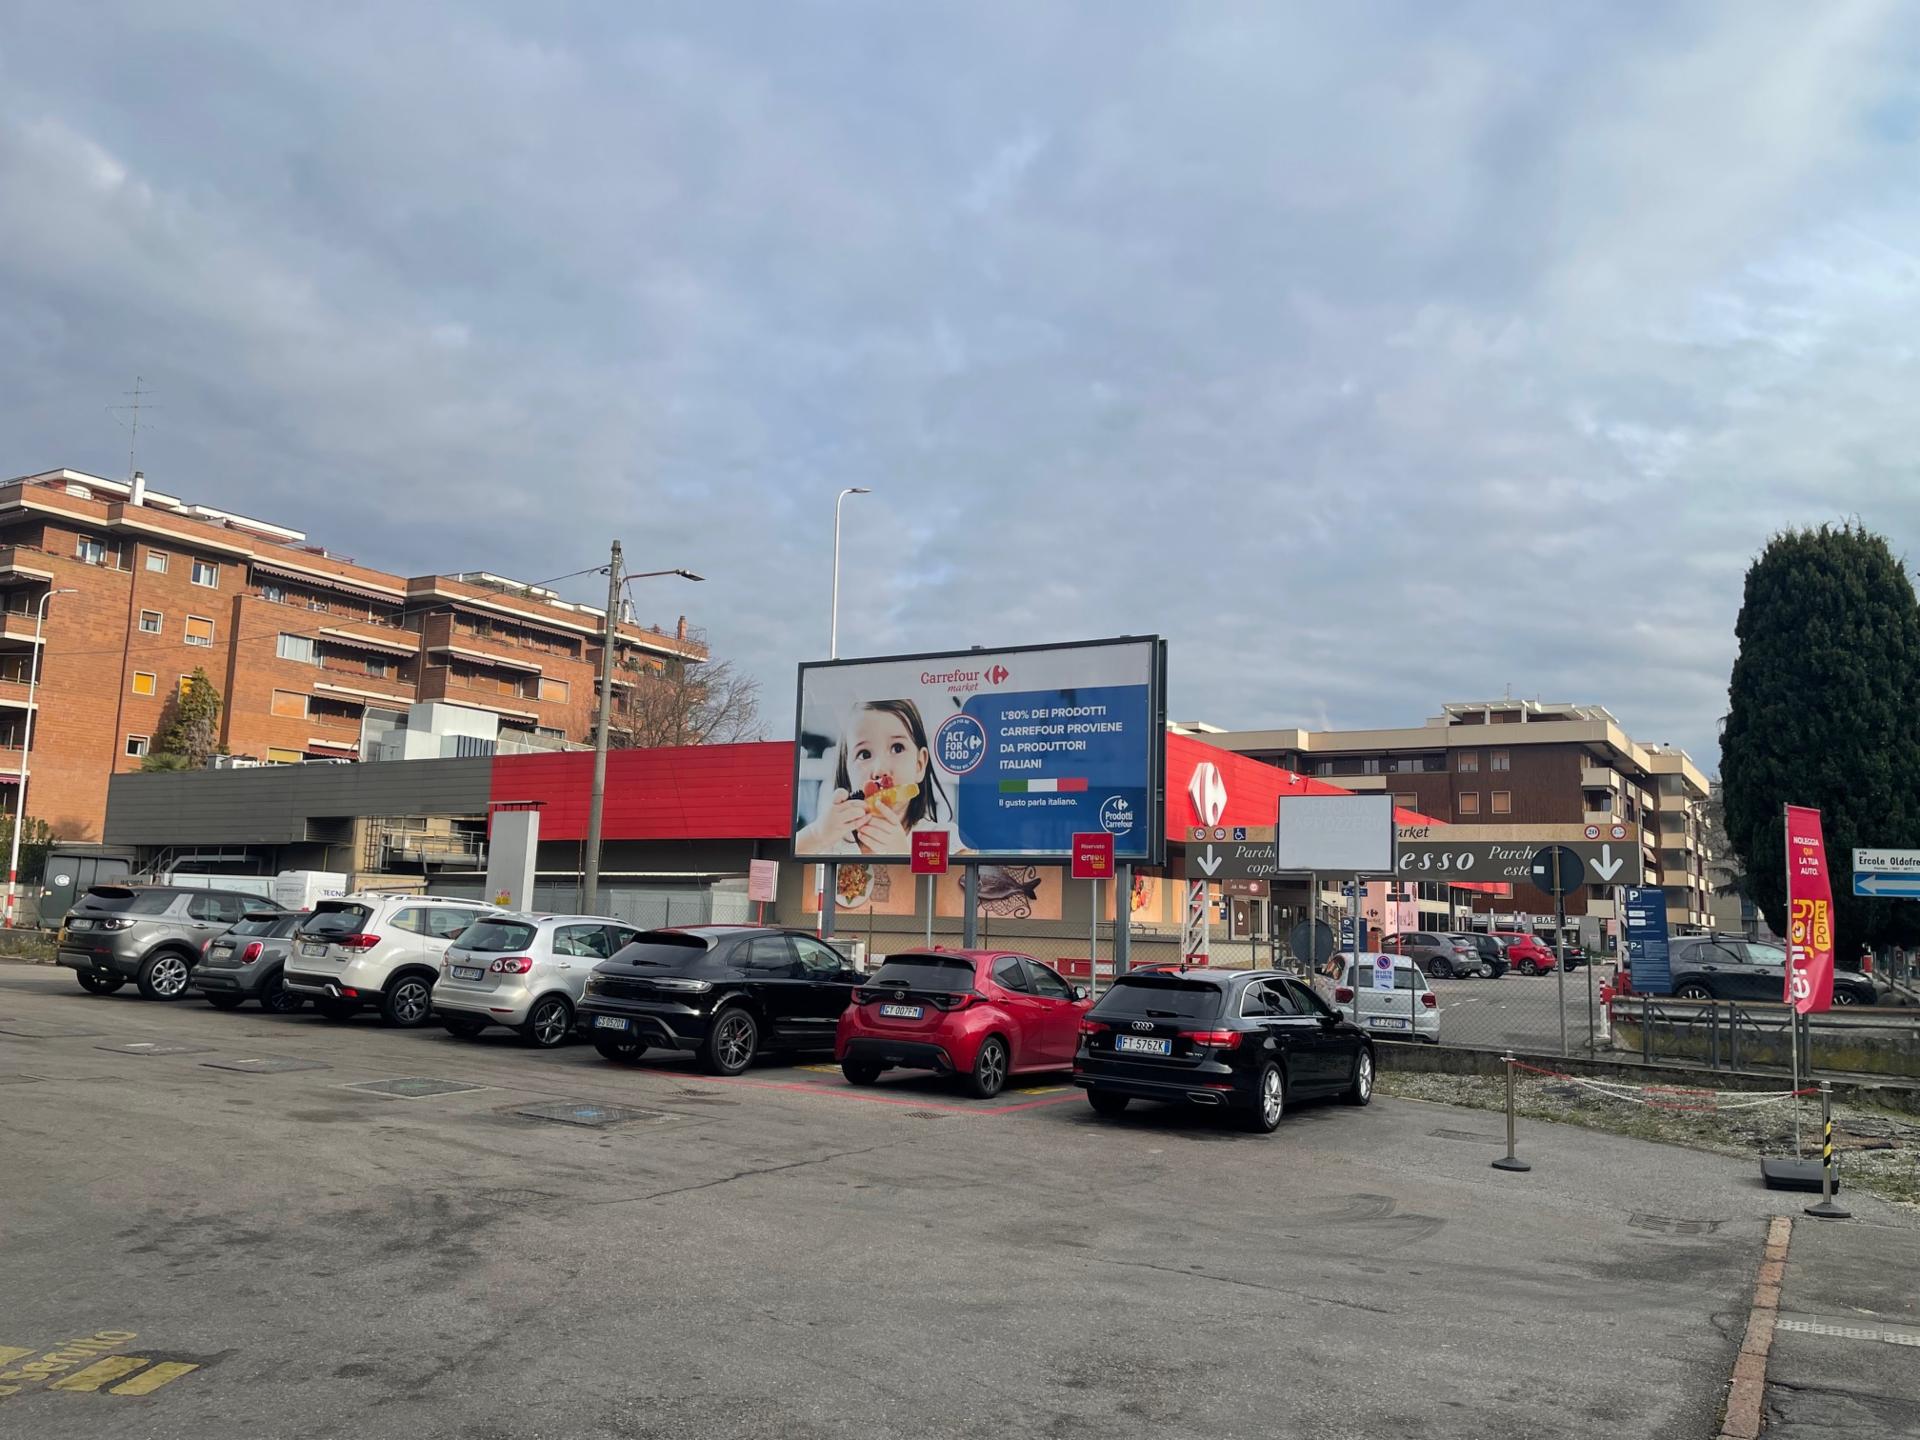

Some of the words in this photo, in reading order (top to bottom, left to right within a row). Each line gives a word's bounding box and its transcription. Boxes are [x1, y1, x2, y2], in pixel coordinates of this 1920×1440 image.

[920, 669, 979, 685] Carrefour
[947, 682, 978, 692] market
[1001, 709, 1029, 720] L'80%
[1031, 708, 1049, 719] DEI
[1051, 706, 1106, 718] PRODOTTI
[1000, 724, 1064, 736] CARREFOUR
[1067, 722, 1123, 733] PROVIENE
[945, 730, 964, 742] ACT
[945, 741, 963, 751] FOR
[1000, 743, 1015, 753] DA
[1017, 740, 1087, 752] PRODUTTORI
[945, 750, 969, 760] FOOD
[999, 759, 1042, 770] ITALIANI
[1005, 799, 1026, 808] gusto
[1027, 798, 1046, 807] parla
[1048, 797, 1078, 806] italiano.
[1105, 810, 1133, 821] Prodotti
[1105, 820, 1133, 828] Carrefour
[1793, 836, 1819, 846] NOLEGGIA
[1798, 857, 1807, 865] LA
[1807, 857, 1819, 865] TUA
[1858, 856, 1885, 865] Ercole
[1629, 890, 1639, 901] P
[1815, 903, 1828, 945] point
[1122, 1037, 1135, 1048] FT
[1136, 1039, 1164, 1052] 576ZK
